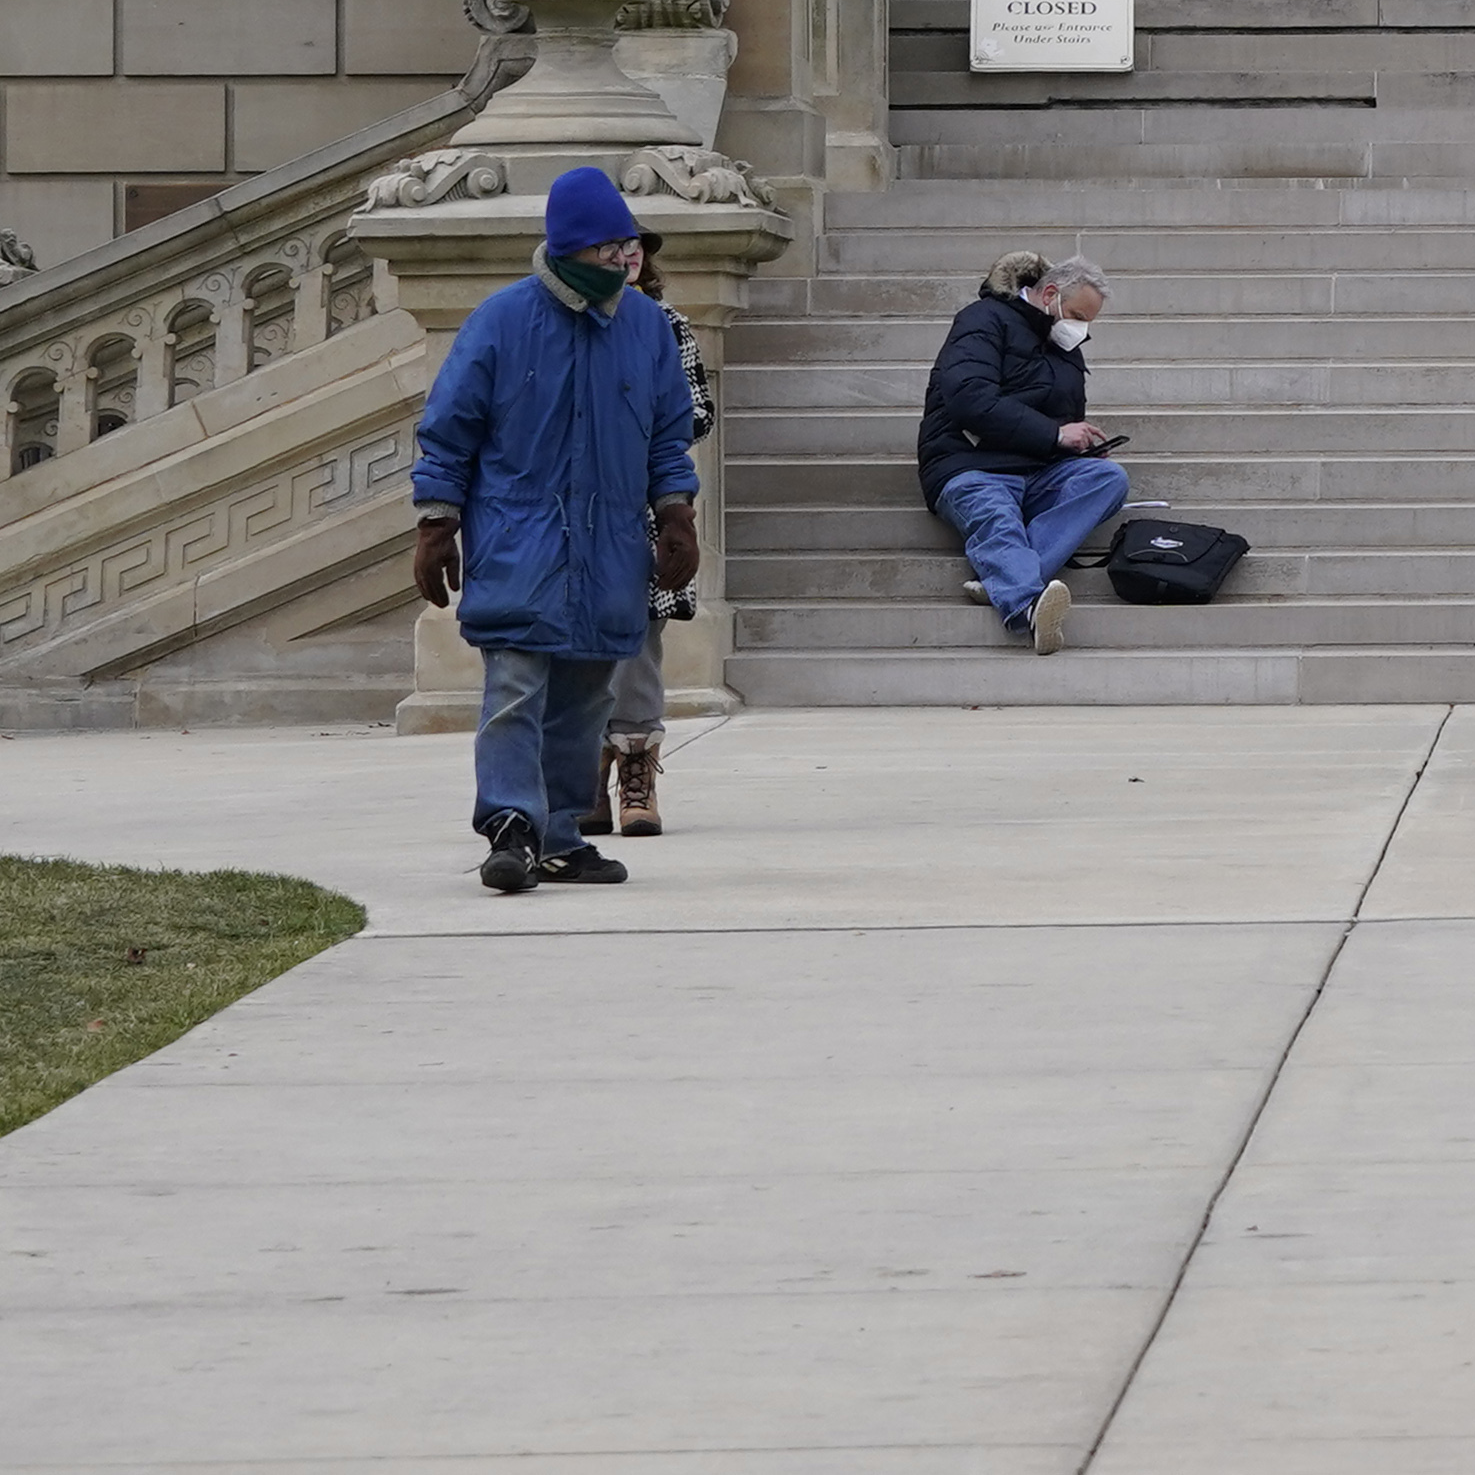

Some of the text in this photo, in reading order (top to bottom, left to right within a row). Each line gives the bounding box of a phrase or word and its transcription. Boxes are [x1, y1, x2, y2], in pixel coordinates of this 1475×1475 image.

[1007, 0, 1097, 15] CLOSED
[992, 22, 1031, 32] Please
[1058, 22, 1113, 32] Entrance
[1013, 34, 1091, 44] Under Stairs
